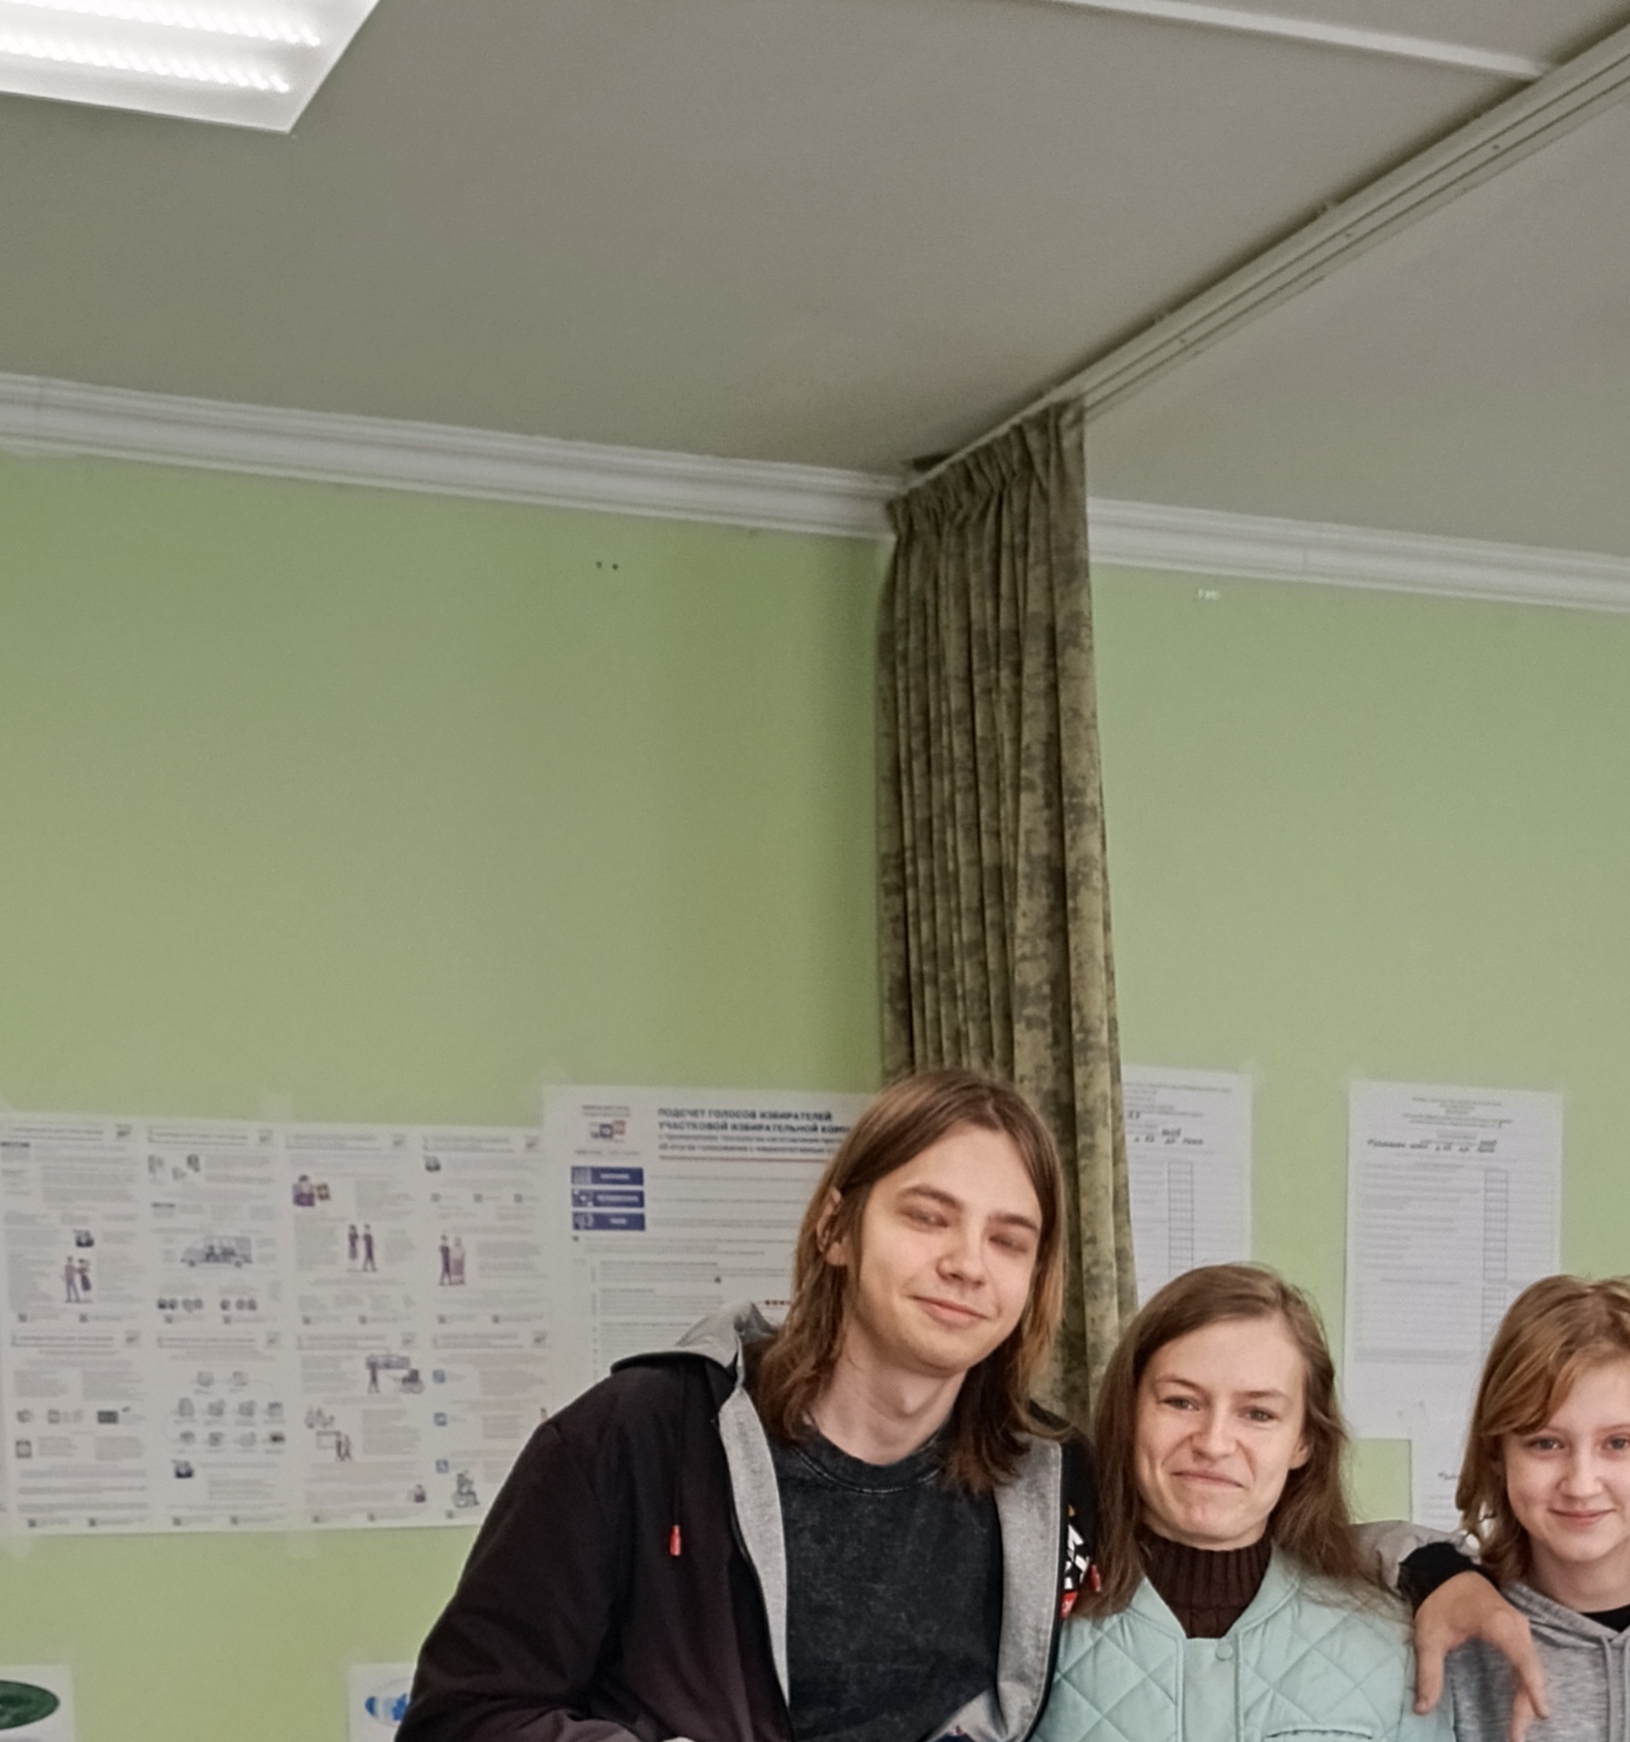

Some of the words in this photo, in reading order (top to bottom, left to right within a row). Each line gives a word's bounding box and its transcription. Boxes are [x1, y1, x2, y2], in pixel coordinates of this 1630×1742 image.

[708, 1109, 757, 1120] ГОЛОСОВ
[759, 1110, 832, 1122] ИЗБИРАТЕЛЕЙ
[657, 1120, 728, 1132] УЧАСТКОВОЙ
[730, 1122, 818, 1134] ИЗБИРАТЕЛЬНОЙ
